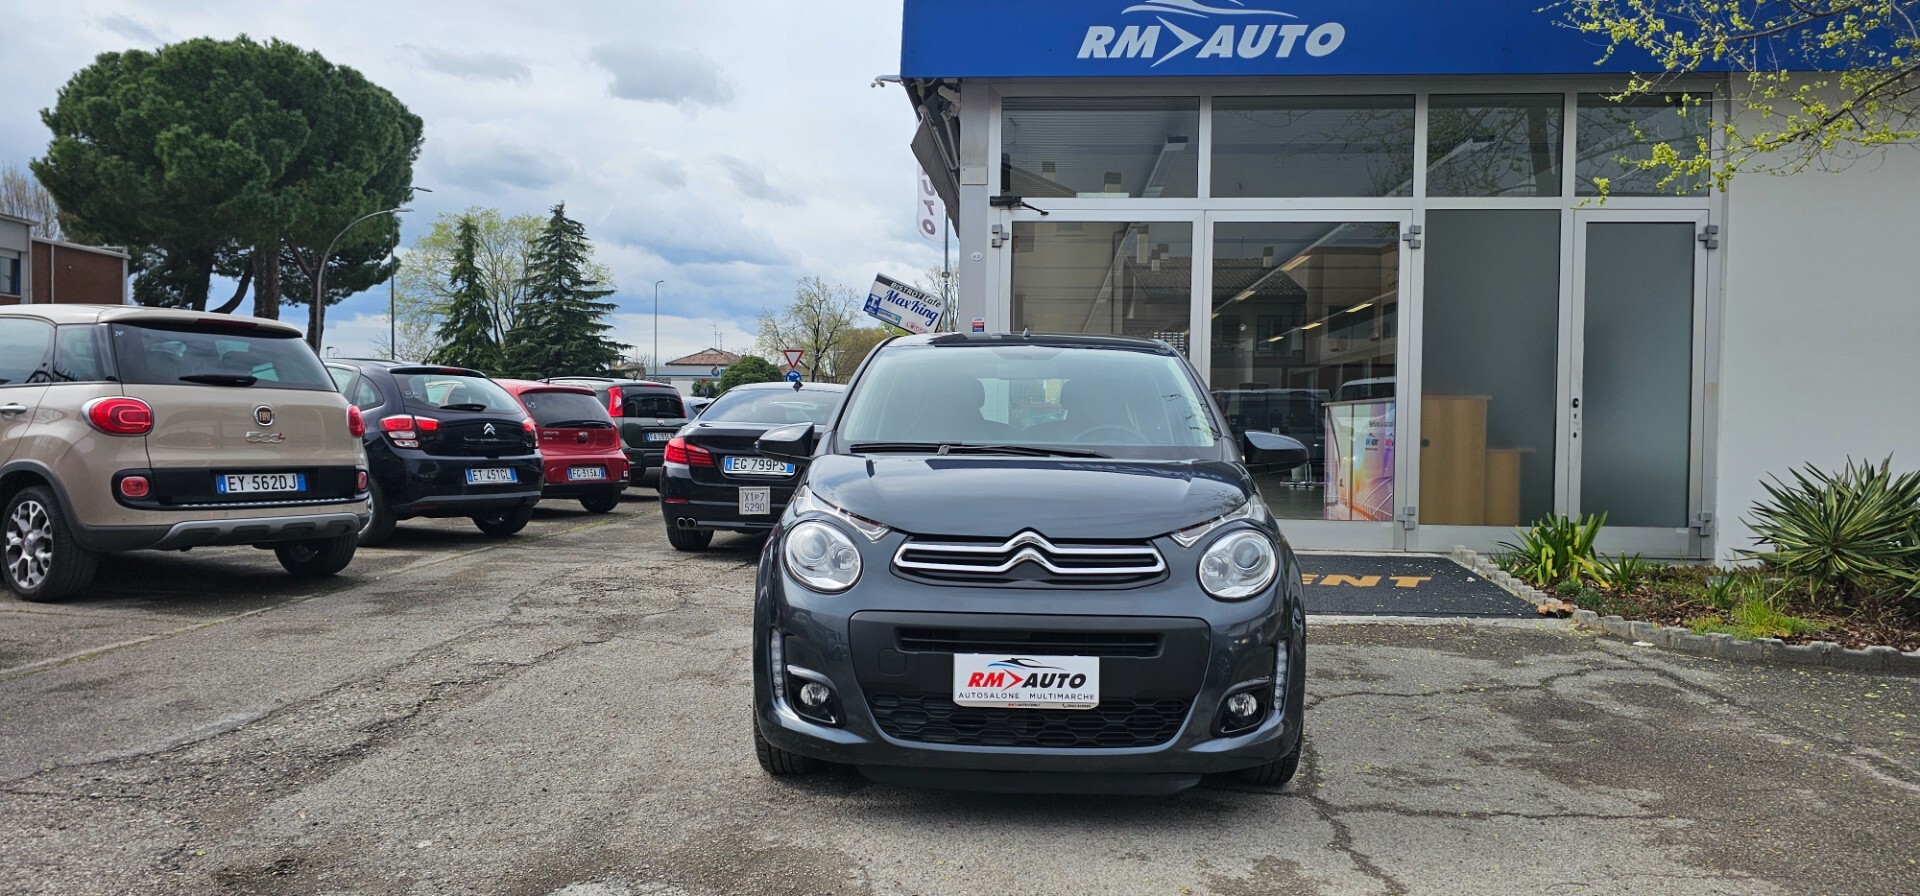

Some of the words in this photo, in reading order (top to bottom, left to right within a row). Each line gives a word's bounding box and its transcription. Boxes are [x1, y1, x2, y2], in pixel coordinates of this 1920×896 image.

[1077, 25, 1161, 59] RM
[1195, 22, 1346, 59] AUTO
[733, 458, 747, 470] EG
[751, 458, 786, 471] 799PS
[472, 470, 483, 481] ET
[486, 468, 511, 480] 451GL
[228, 476, 245, 491] EY
[252, 474, 297, 490] 562DJ
[744, 503, 765, 512] 5290
[967, 672, 1005, 688] RM
[1021, 672, 1087, 689] AUTO
[958, 692, 1020, 700] AUTOSALONE
[1029, 692, 1095, 701] MULTIMARCHE
